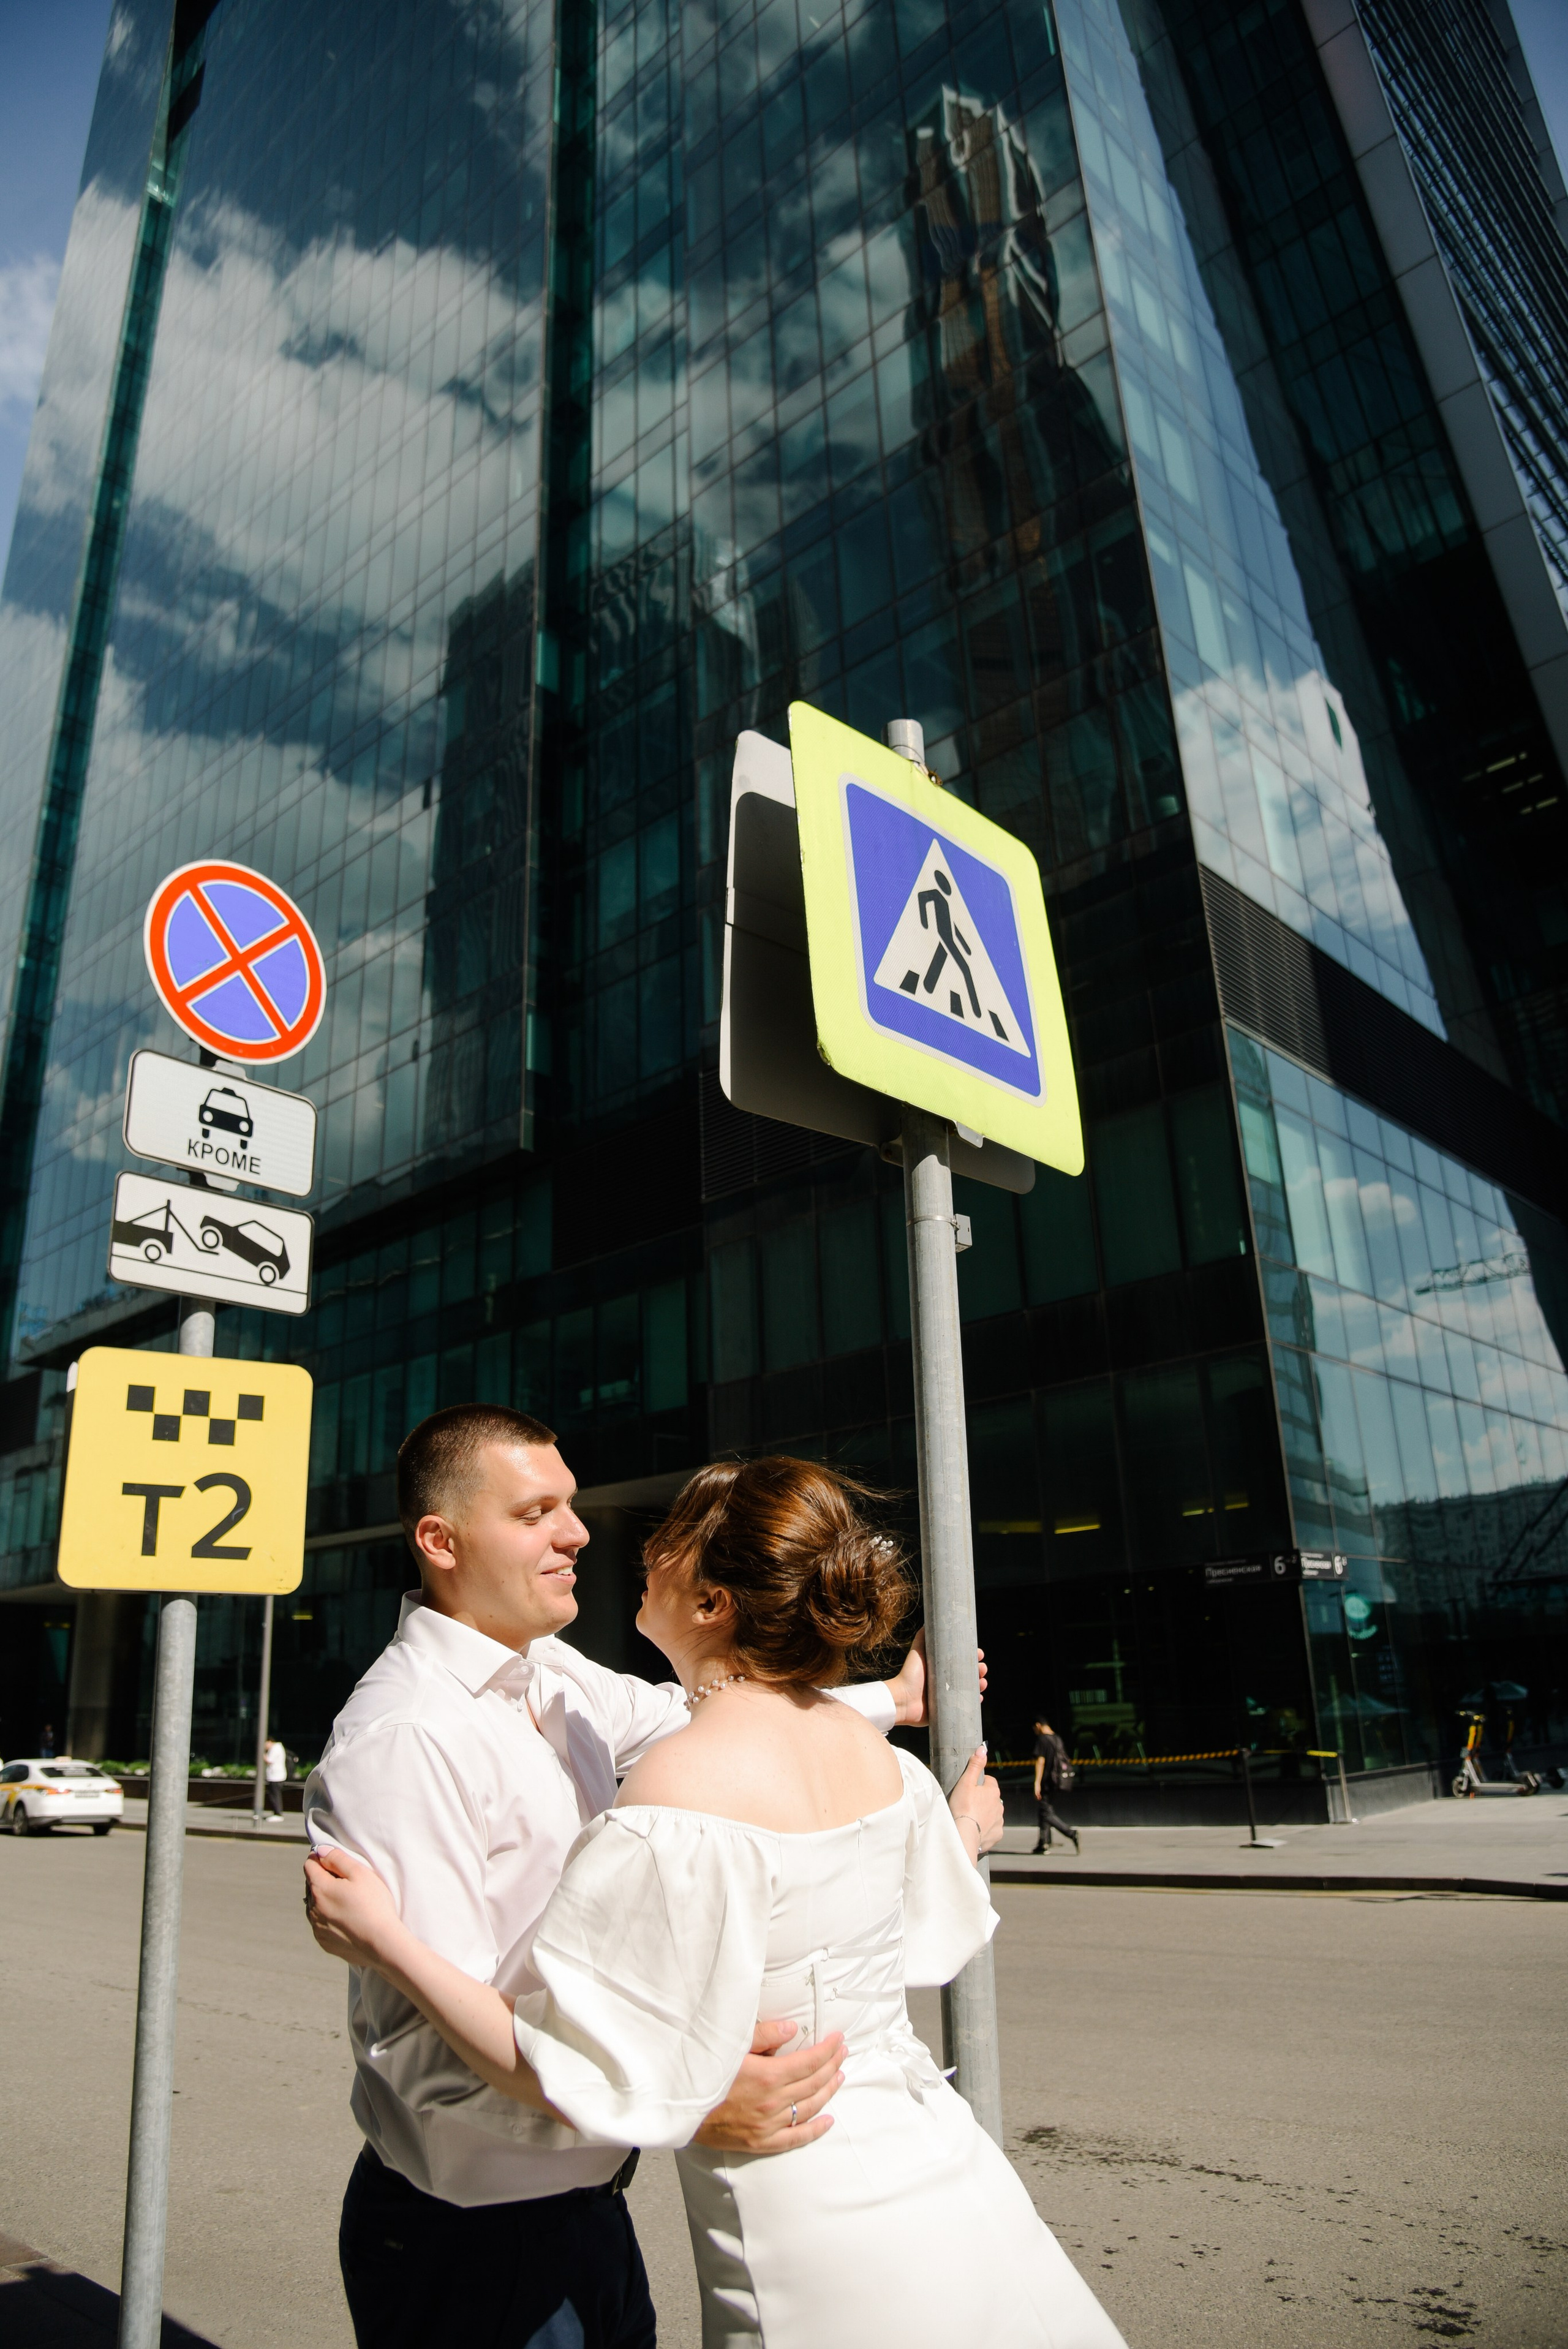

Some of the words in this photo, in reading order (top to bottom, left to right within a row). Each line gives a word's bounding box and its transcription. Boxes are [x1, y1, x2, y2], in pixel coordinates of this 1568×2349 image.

[187, 1139, 262, 1175] КРОМЕ
[121, 1472, 253, 1561] Т2
[1274, 1555, 1286, 1575] 6
